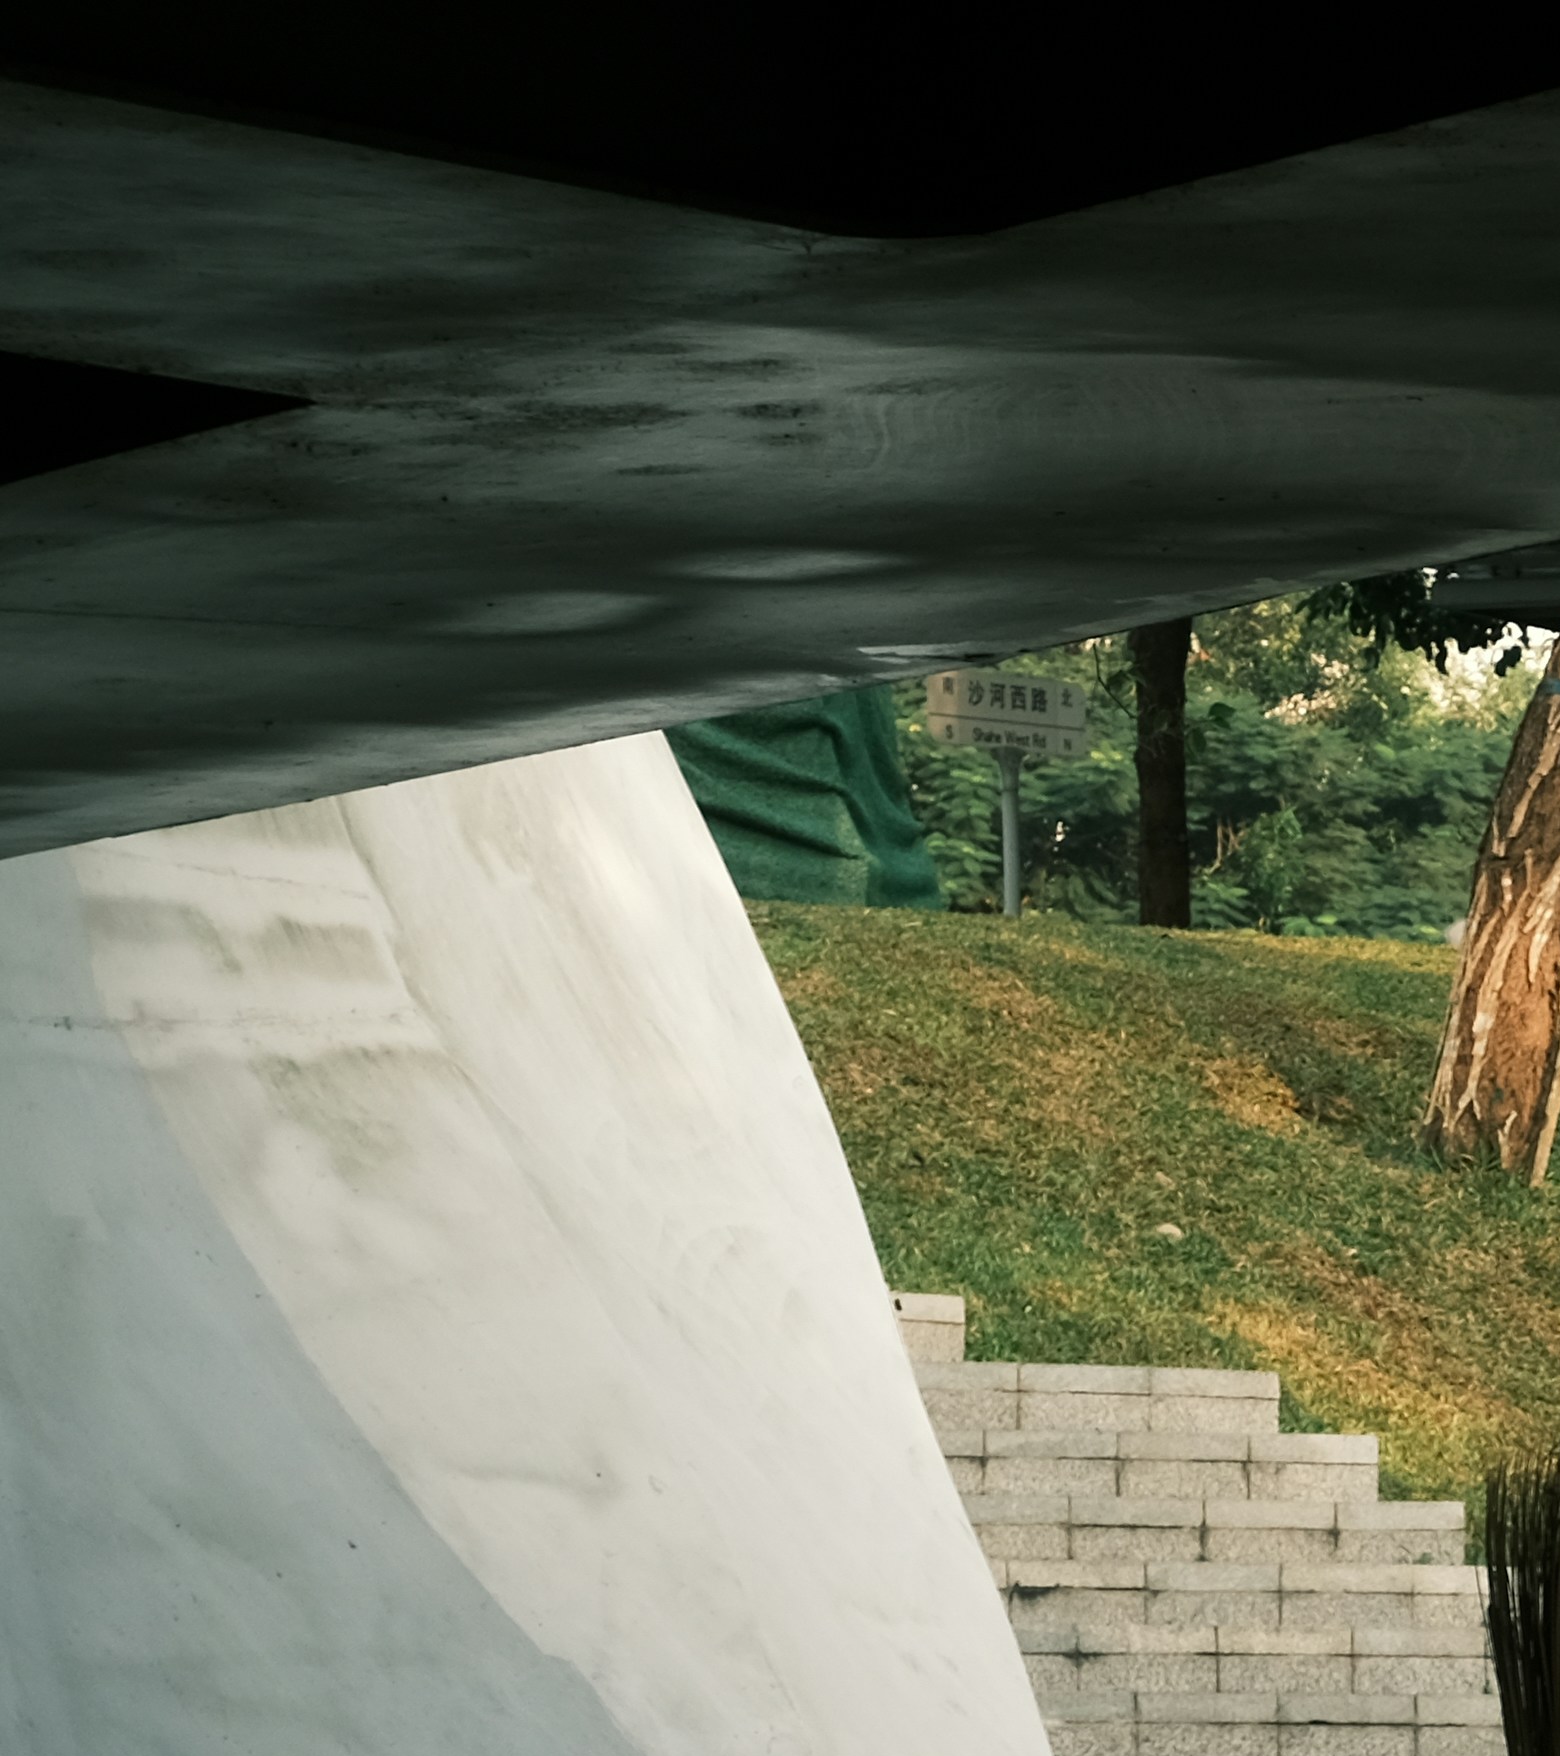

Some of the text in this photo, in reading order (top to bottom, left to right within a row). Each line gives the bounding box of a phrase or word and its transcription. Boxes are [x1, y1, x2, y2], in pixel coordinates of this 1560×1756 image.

[968, 680, 1048, 713] 沙河西路
[1062, 688, 1073, 708] 北
[945, 724, 1072, 751] S Shahe West Rd N
